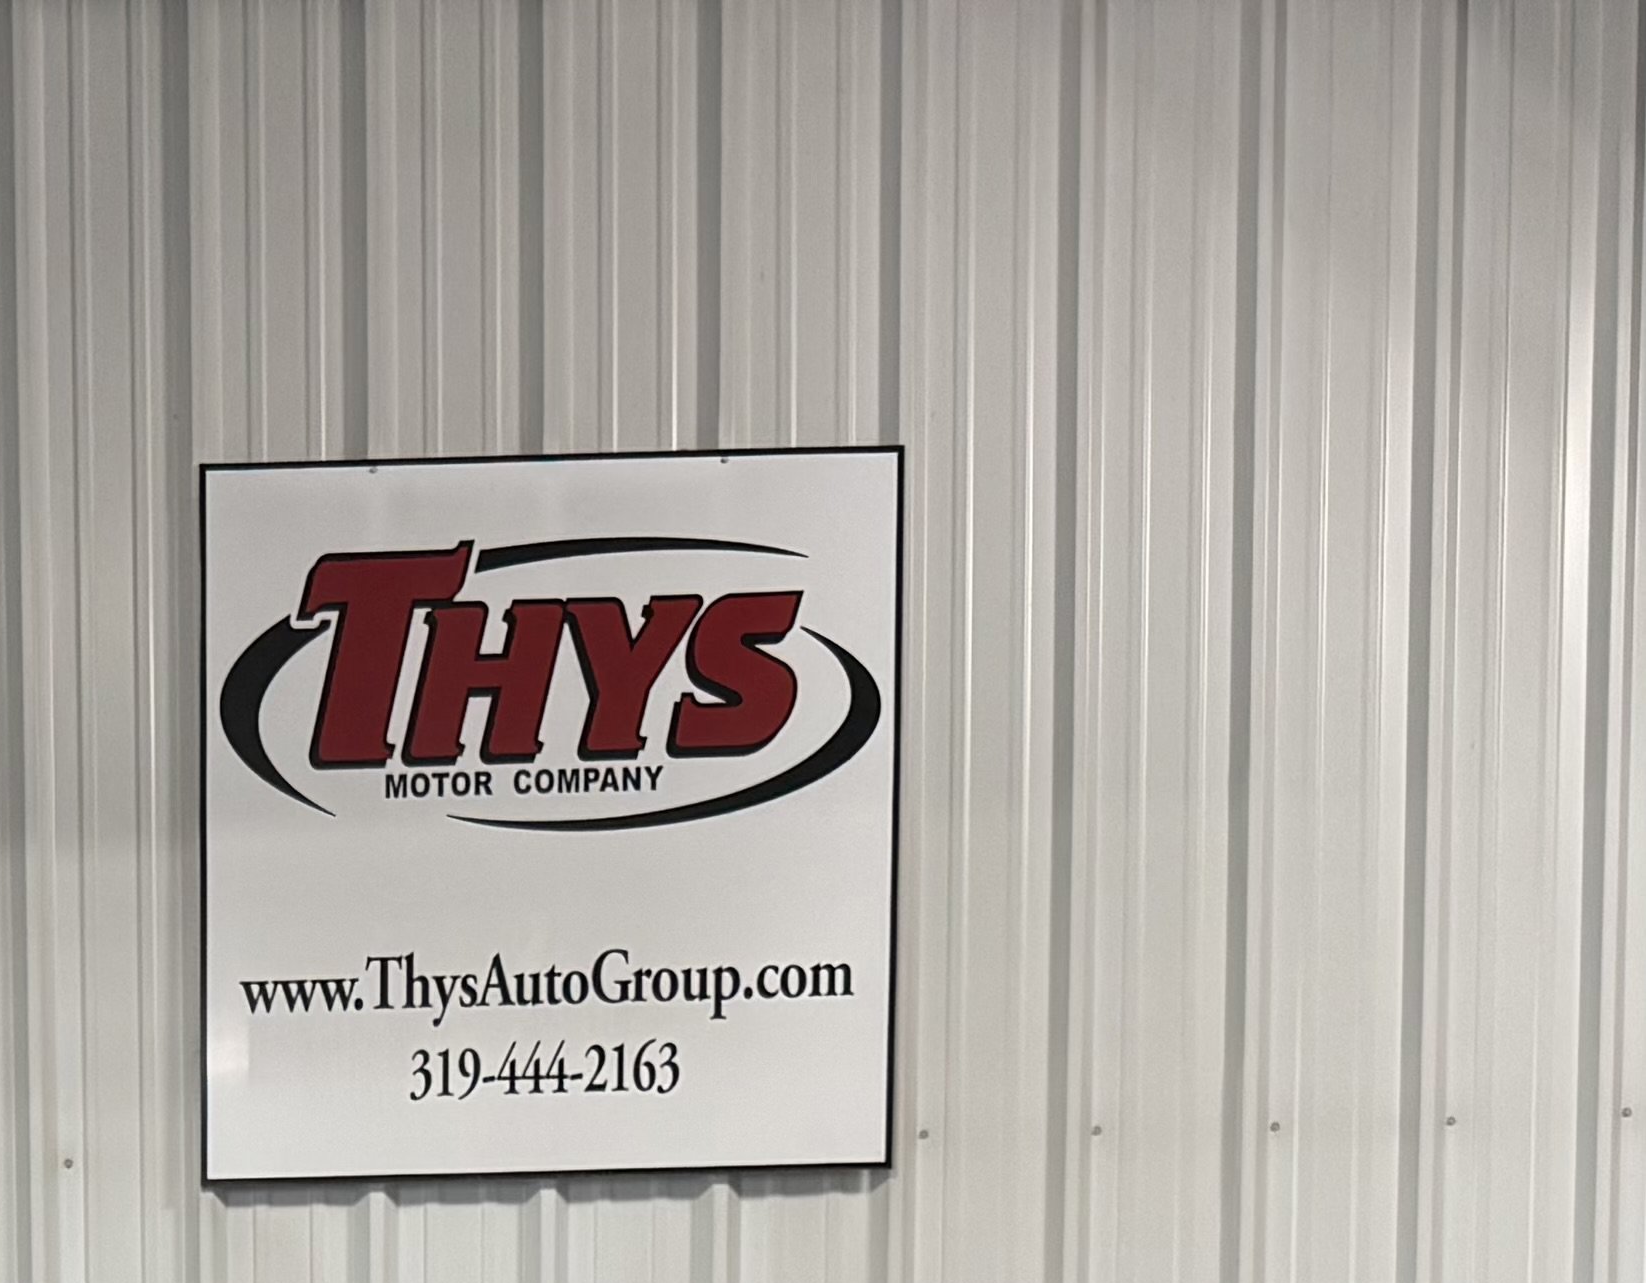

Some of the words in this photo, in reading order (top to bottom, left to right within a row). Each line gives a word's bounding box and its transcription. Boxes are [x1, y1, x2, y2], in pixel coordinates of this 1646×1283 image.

[296, 539, 805, 770] THYS
[384, 770, 493, 799] MOTOR
[512, 765, 664, 795] COMPANY
[239, 949, 854, 1027] www.ThysAutoGroup.com
[409, 1038, 681, 1102] 319-444-2163
